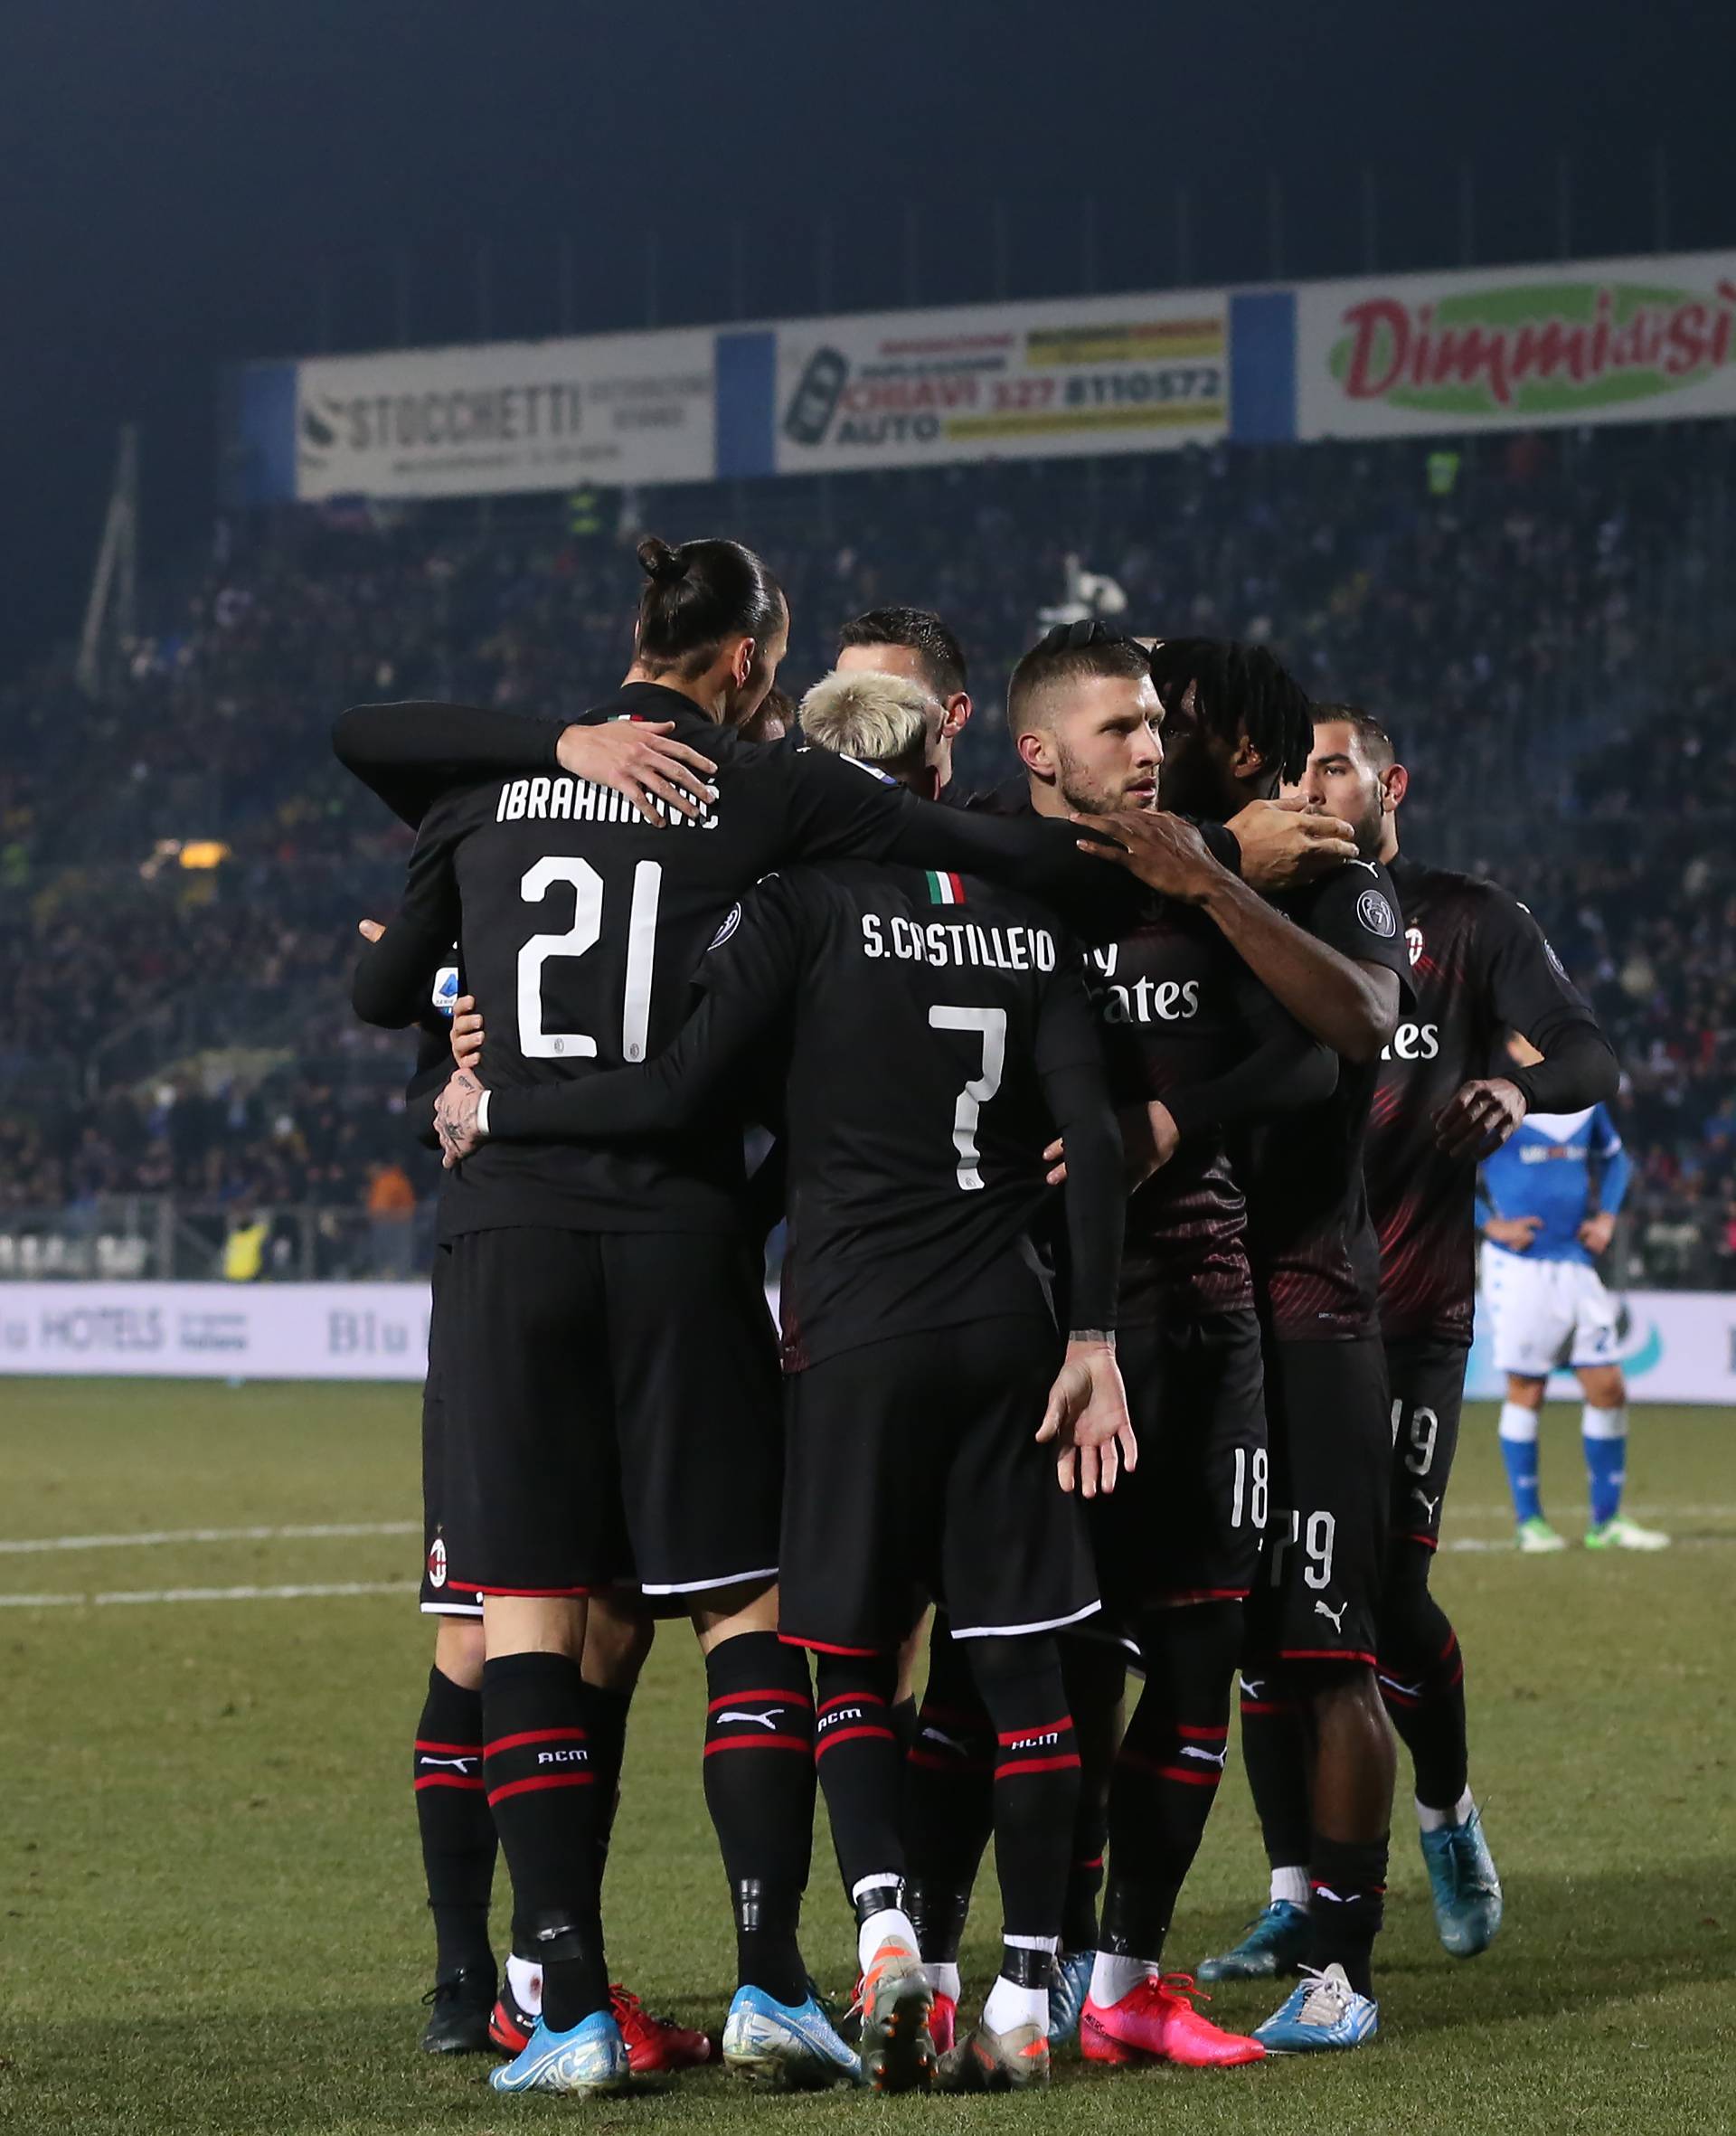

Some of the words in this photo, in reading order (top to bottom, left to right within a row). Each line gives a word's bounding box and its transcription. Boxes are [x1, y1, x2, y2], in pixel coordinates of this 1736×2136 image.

[349, 381, 582, 450] STOCCHETTI
[837, 413, 941, 445] AUTO
[517, 855, 662, 1063] 21
[1101, 976, 1200, 1024] ates
[929, 1005, 1007, 1191] 7
[41, 1307, 165, 1351] HOTELS
[328, 1309, 409, 1354] Blu
[1231, 1448, 1268, 1529] 18
[537, 1749, 589, 1765] ACM
